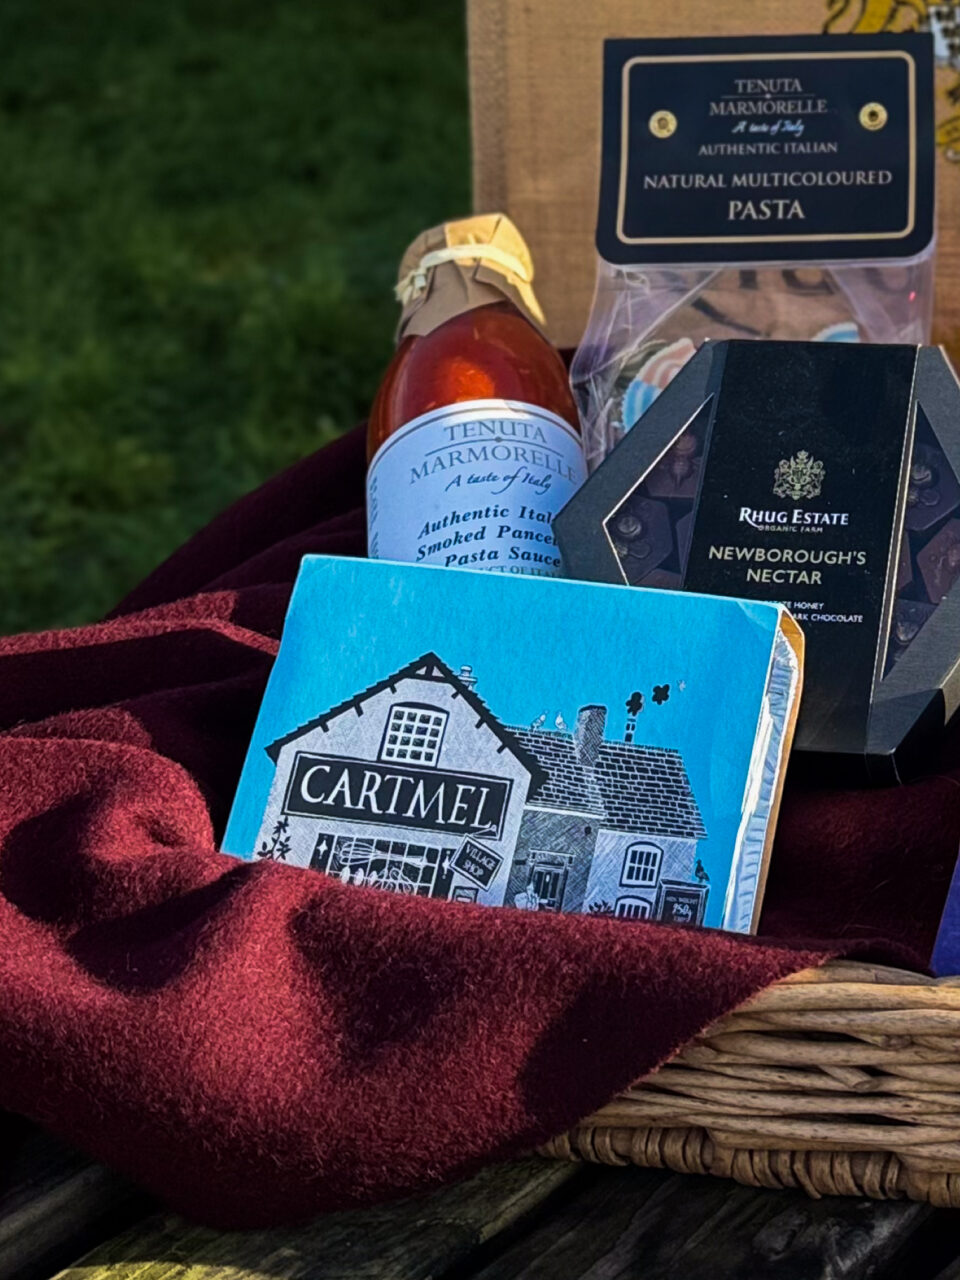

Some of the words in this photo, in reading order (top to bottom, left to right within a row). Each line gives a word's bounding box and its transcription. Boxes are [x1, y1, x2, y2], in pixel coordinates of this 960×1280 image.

[734, 78, 803, 94] TENUTA
[709, 99, 828, 116] MARMORELLE
[698, 143, 781, 156] AUTHENTIC
[784, 141, 838, 155] ITALIAN
[643, 173, 728, 191] NATURAL
[732, 170, 893, 188] MULTICOLOURED
[727, 199, 806, 221] PASTA
[443, 421, 548, 444] TENUTA
[408, 445, 578, 485] MARMORELLE
[445, 474, 461, 492] A
[467, 472, 501, 485] taste
[490, 466, 528, 496] of
[521, 472, 553, 496] Italy
[417, 504, 510, 540] Authentic
[518, 505, 553, 524] Ital
[738, 507, 788, 529] RHUG
[791, 509, 849, 525] ESTATE
[416, 526, 486, 563] Smoked
[709, 546, 867, 565] NEWBOROUGH'S
[445, 549, 500, 568] Pasta
[508, 546, 561, 568] Sauce
[746, 568, 822, 585] NECTAR
[794, 601, 824, 610] HONEY
[811, 613, 864, 623] CHOCOLATE
[300, 764, 492, 829] CARTMEL
